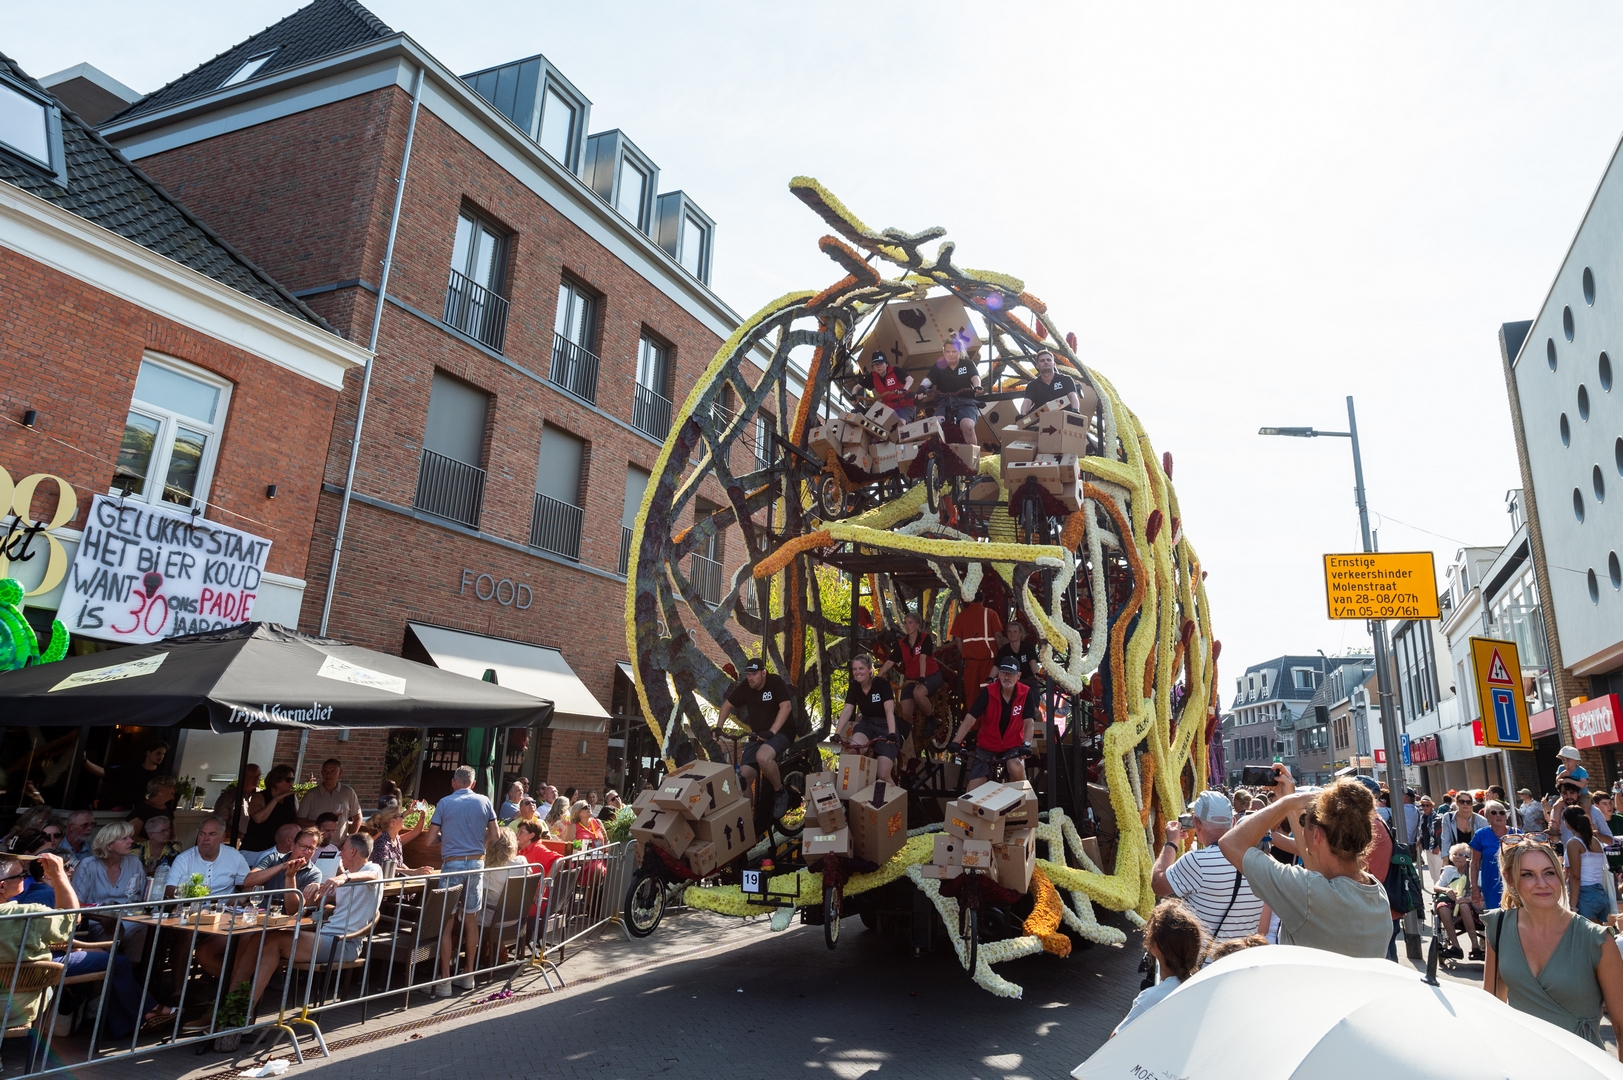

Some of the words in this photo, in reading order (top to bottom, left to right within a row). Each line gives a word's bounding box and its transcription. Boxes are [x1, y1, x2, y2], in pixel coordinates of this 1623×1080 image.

[97, 500, 211, 549] GELUKKIG
[206, 530, 269, 566] STAAT
[83, 526, 140, 567] HET
[203, 559, 260, 590] KOUD
[1330, 558, 1375, 569] Ernstige
[1331, 569, 1412, 579] verkeershinder
[74, 563, 139, 603] WANT
[460, 568, 533, 610] FOOD
[1332, 582, 1397, 591] Molenstraat
[1333, 596, 1352, 604] van
[1356, 593, 1418, 604] 28-08/07h
[111, 590, 168, 636] 30
[1334, 606, 1356, 616] t/m
[1359, 606, 1419, 616] 05-09/16h
[229, 703, 270, 727] Tripel
[271, 701, 333, 722] Karmeliet
[1401, 736, 1407, 752] P
[744, 873, 758, 885] 19
